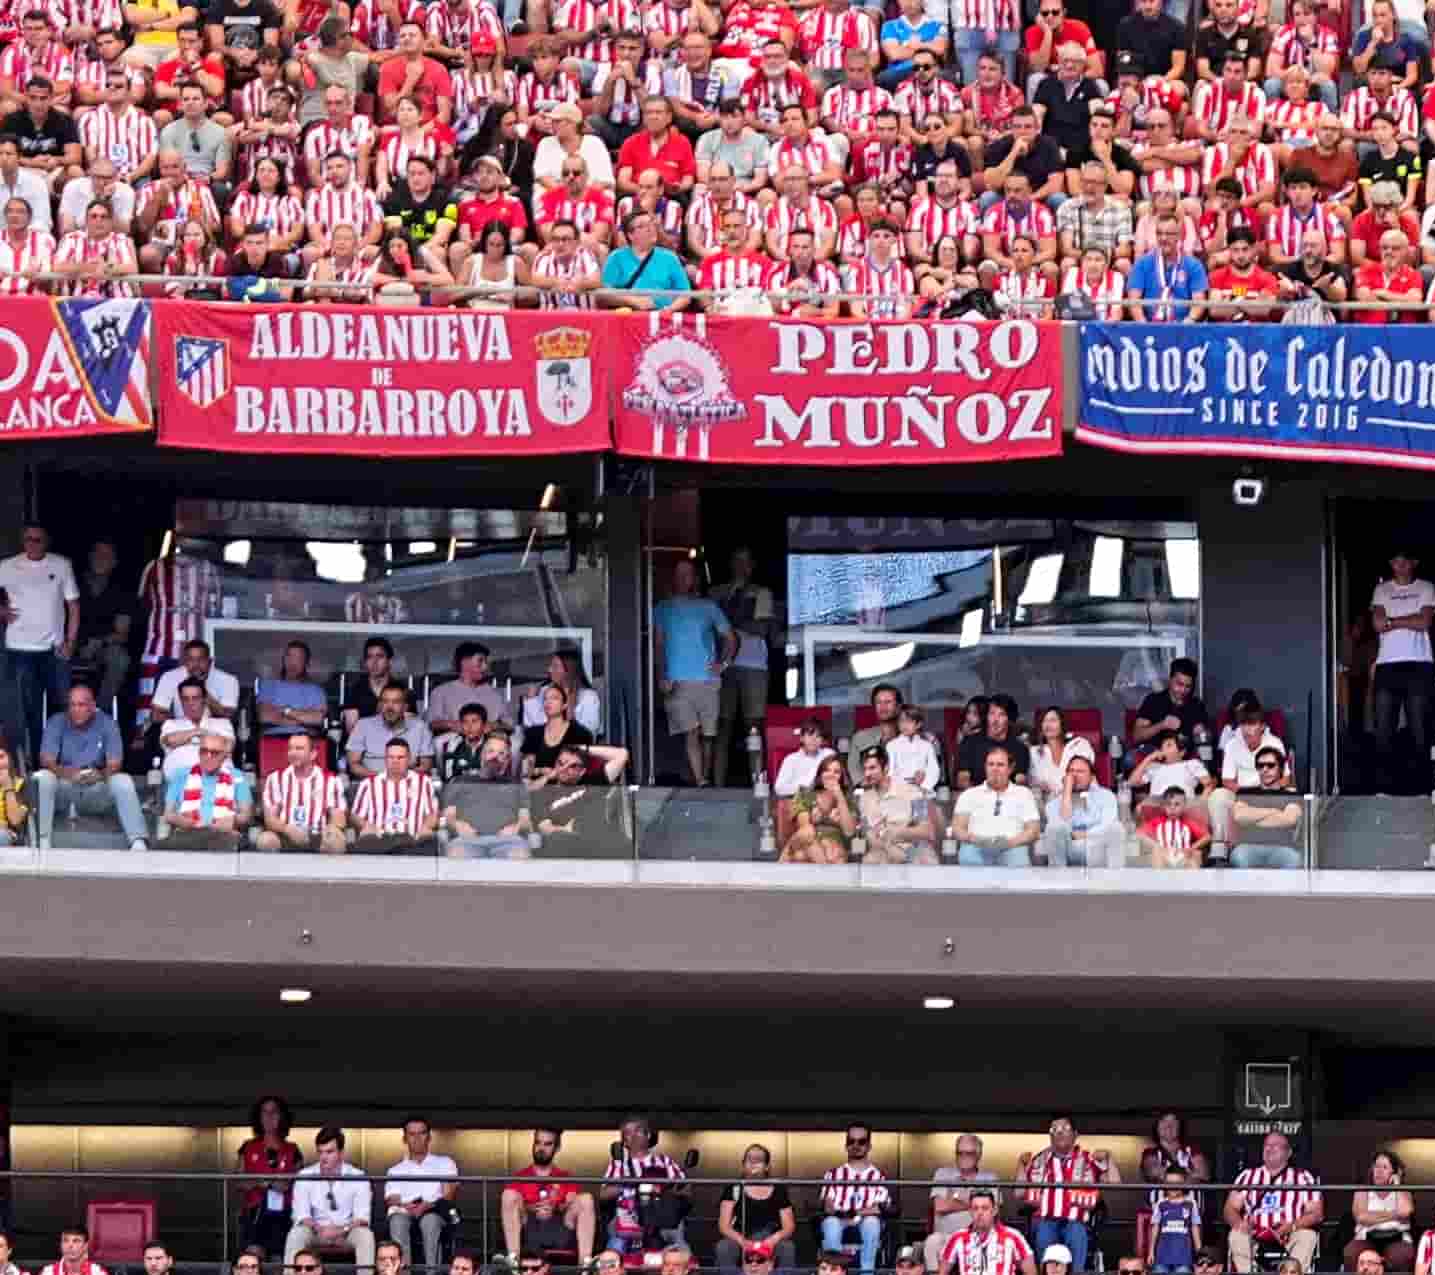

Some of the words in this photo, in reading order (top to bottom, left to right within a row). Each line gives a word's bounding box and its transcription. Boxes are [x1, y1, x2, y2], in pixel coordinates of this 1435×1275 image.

[249, 312, 512, 362] ALDEANUEVA
[769, 319, 1040, 381] PEDRO
[371, 368, 393, 386] DE
[1224, 338, 1269, 399] de
[0, 393, 97, 433] ANCA
[235, 386, 532, 437] BARBARROYA
[753, 384, 1055, 449] MUÑOZ
[1201, 397, 1280, 430] SINCE
[1297, 401, 1360, 431] 2016
